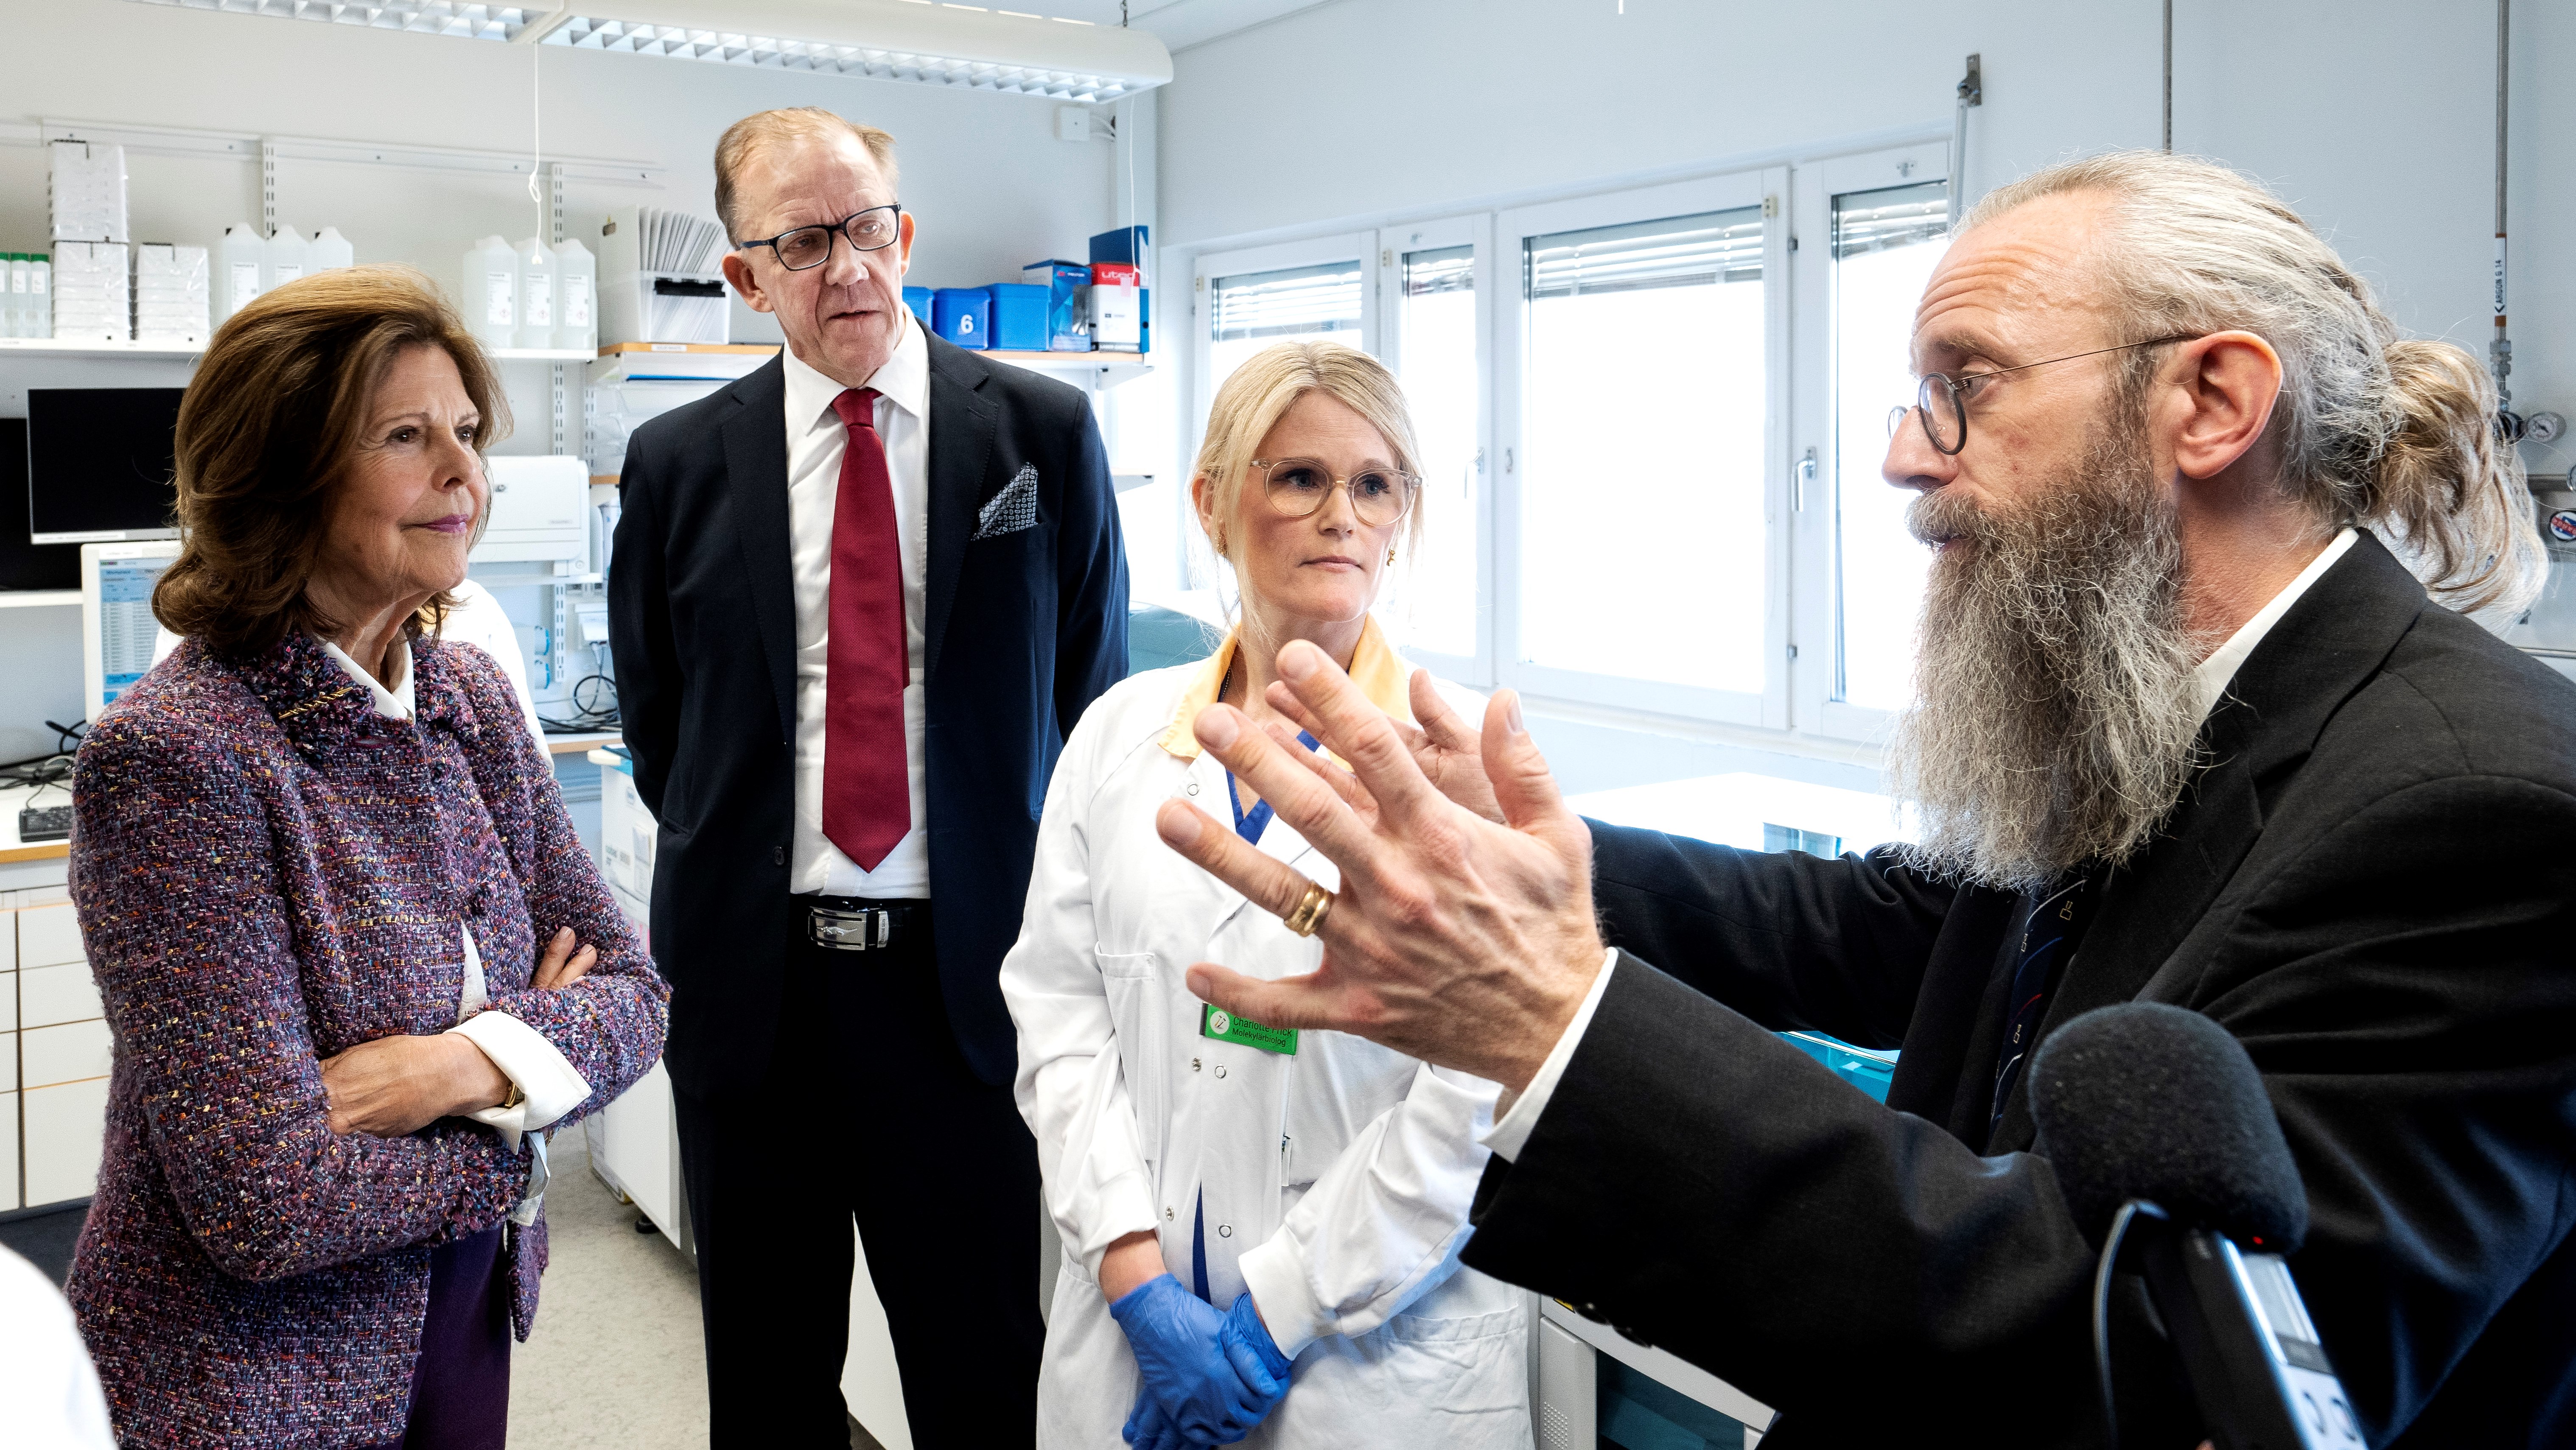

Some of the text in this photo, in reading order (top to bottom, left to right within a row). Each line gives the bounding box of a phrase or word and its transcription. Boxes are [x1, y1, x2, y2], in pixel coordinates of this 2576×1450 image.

[960, 314, 974, 334] 6
[1233, 1017, 1270, 1032] Charlotte
[1232, 1028, 1286, 1048] Molekylärbiolog
